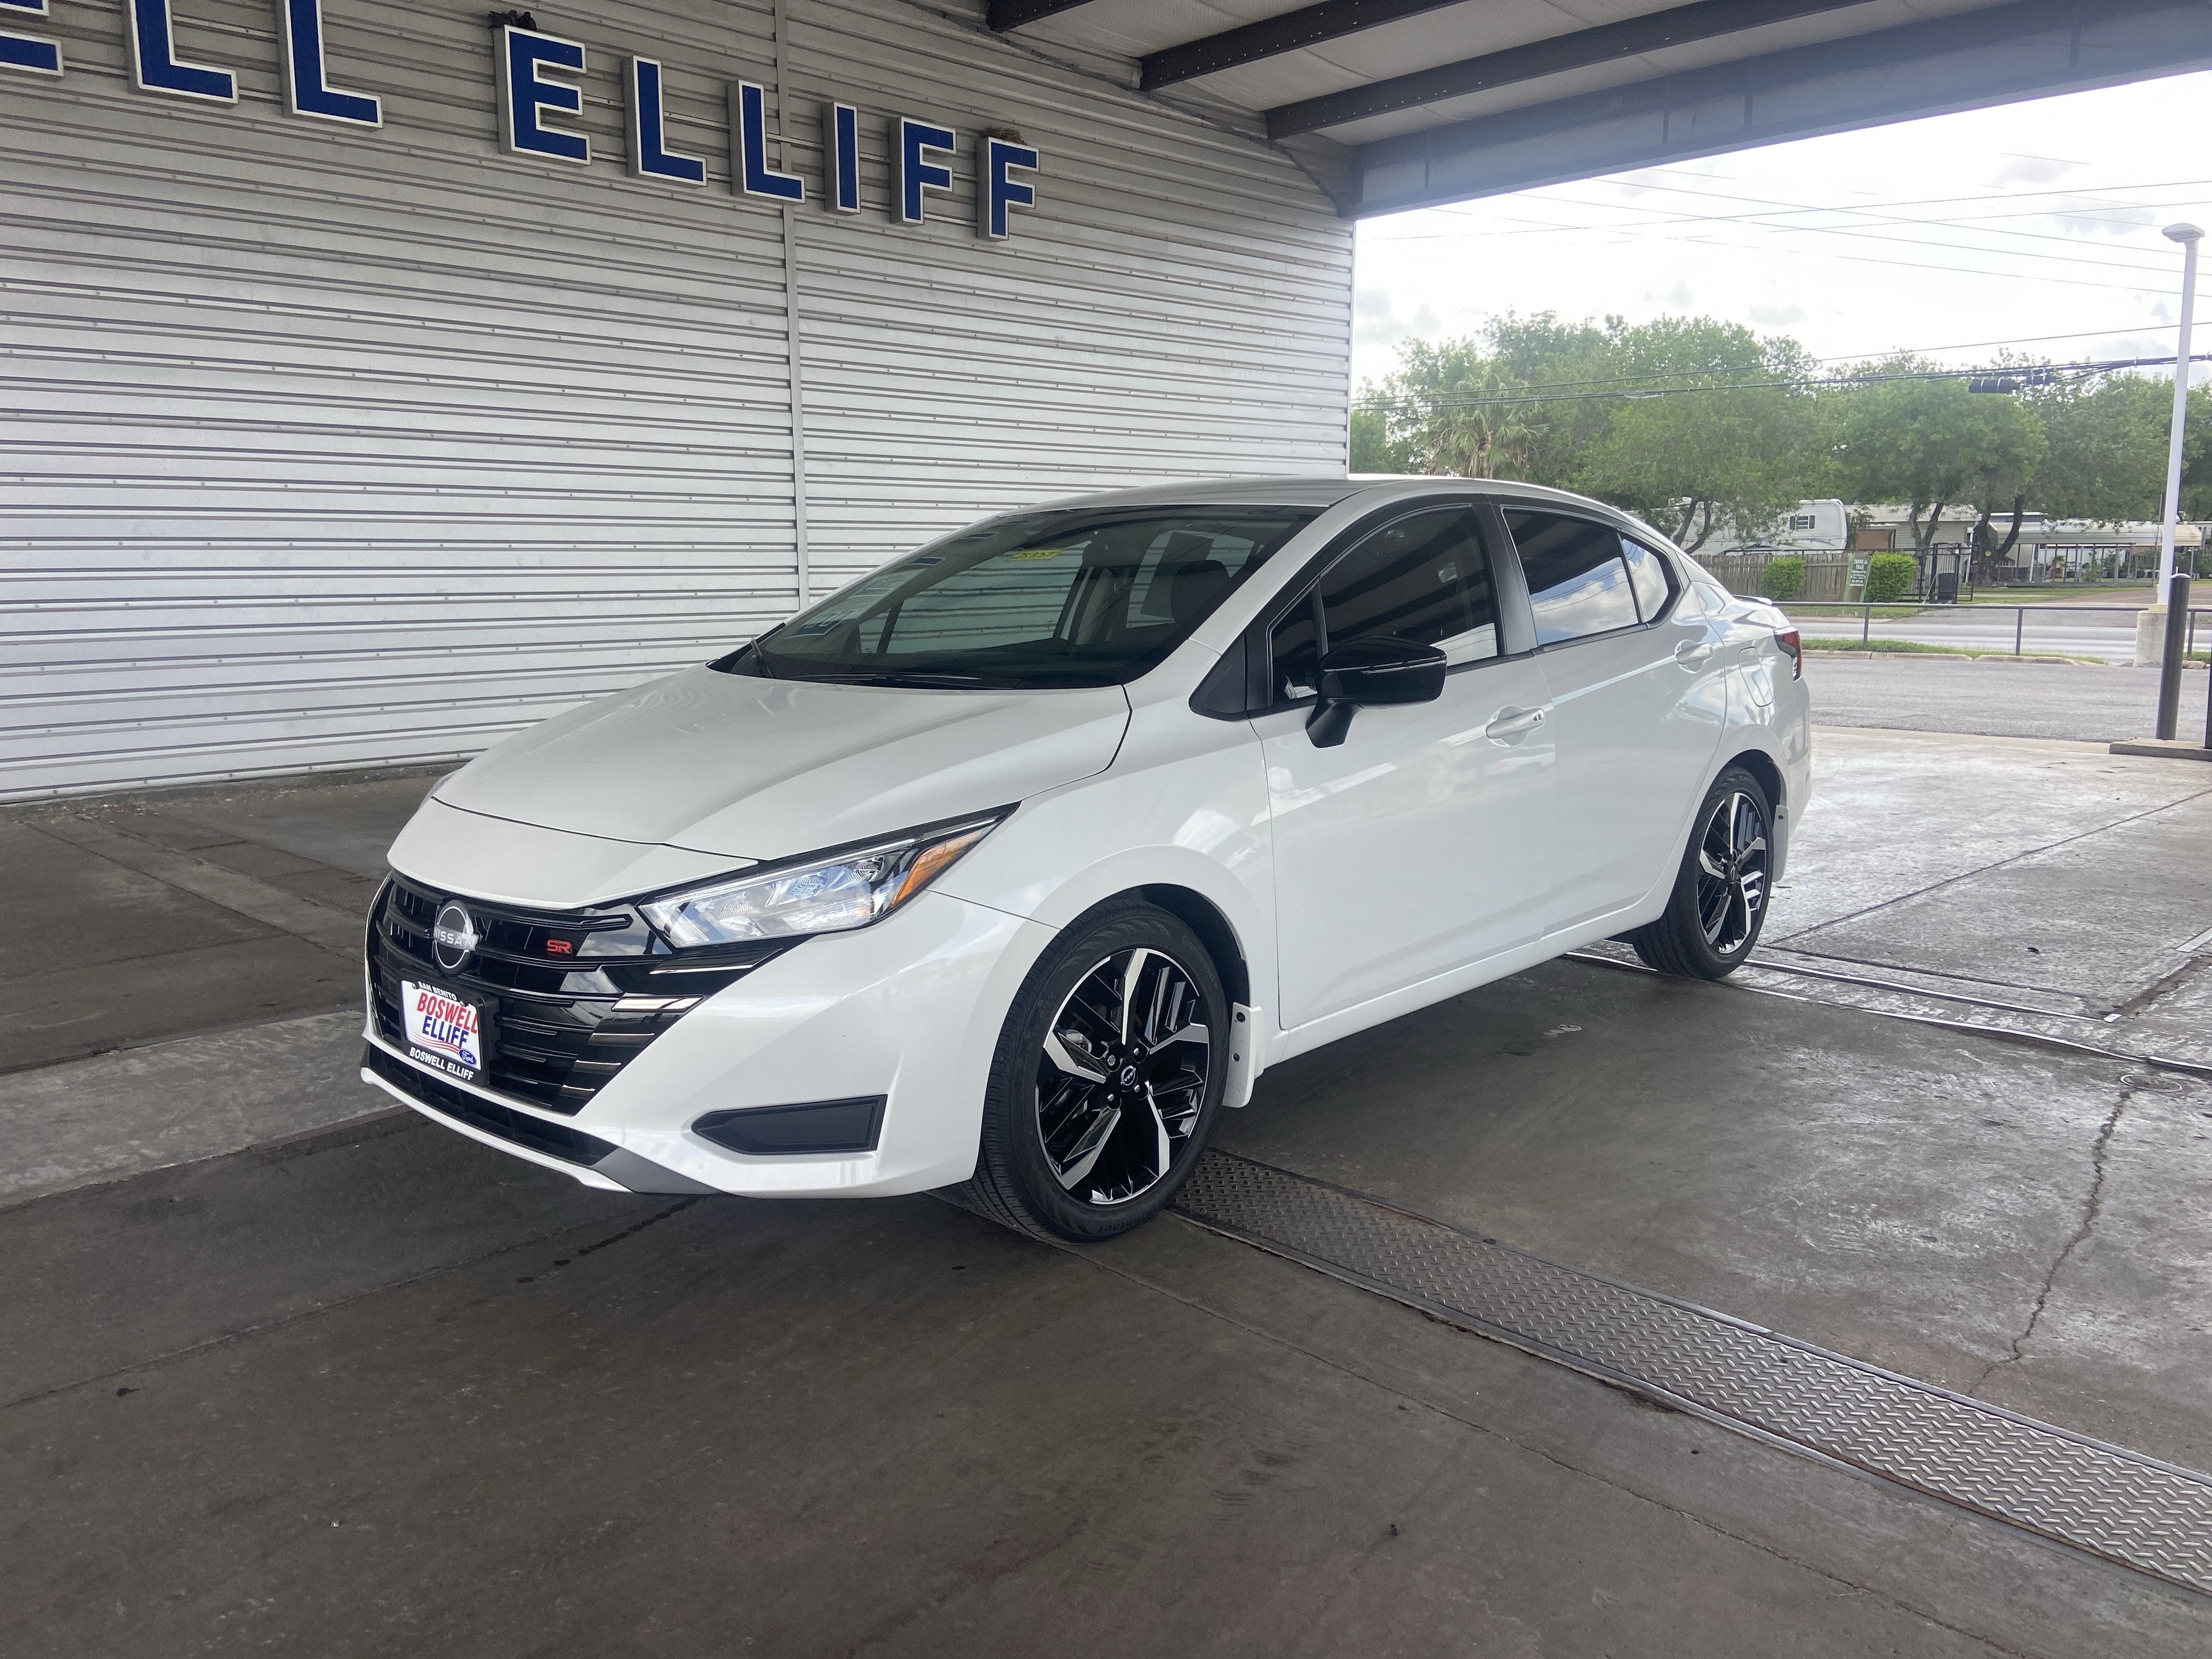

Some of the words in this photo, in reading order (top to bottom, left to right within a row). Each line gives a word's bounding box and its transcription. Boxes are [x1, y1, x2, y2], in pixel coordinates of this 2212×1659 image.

[497, 24, 1040, 241] ELLIFF
[434, 926, 476, 949] NISSAN
[547, 939, 572, 953] SR
[418, 981, 432, 992] SAN
[432, 984, 457, 1001] BENITO
[417, 992, 478, 1035] BOSWELL
[422, 1015, 469, 1049] ELLIFF
[409, 1047, 445, 1070] BOSWELL
[447, 1062, 474, 1081] ELLIFF
[461, 1051, 474, 1063] Ford
